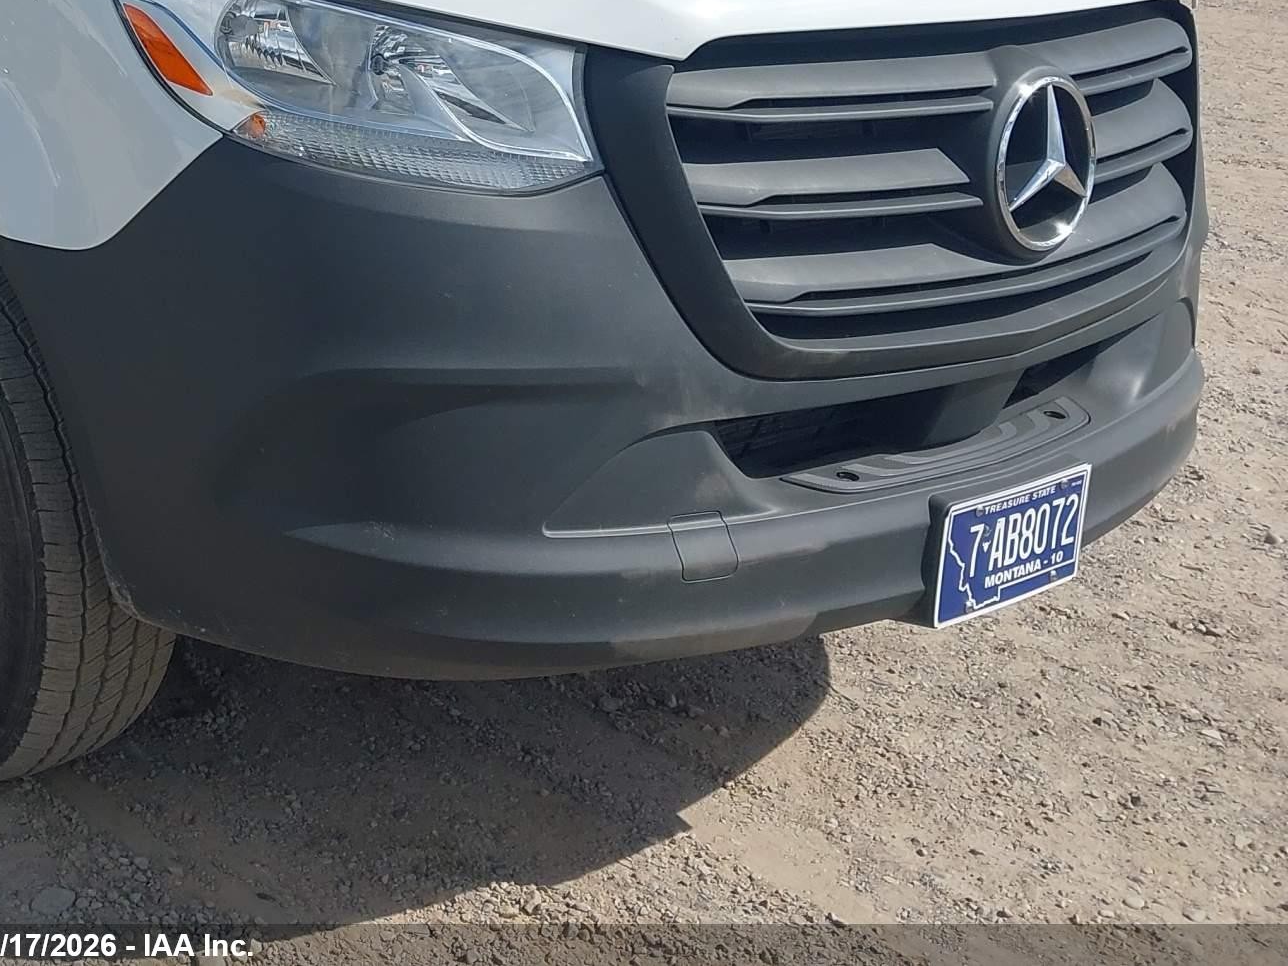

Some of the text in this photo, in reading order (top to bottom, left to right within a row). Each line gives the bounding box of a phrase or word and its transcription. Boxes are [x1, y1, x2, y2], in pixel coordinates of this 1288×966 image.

[985, 486, 1056, 514] TREASURE STATE
[984, 558, 1042, 588] MONTANA
[1051, 550, 1064, 566] 10
